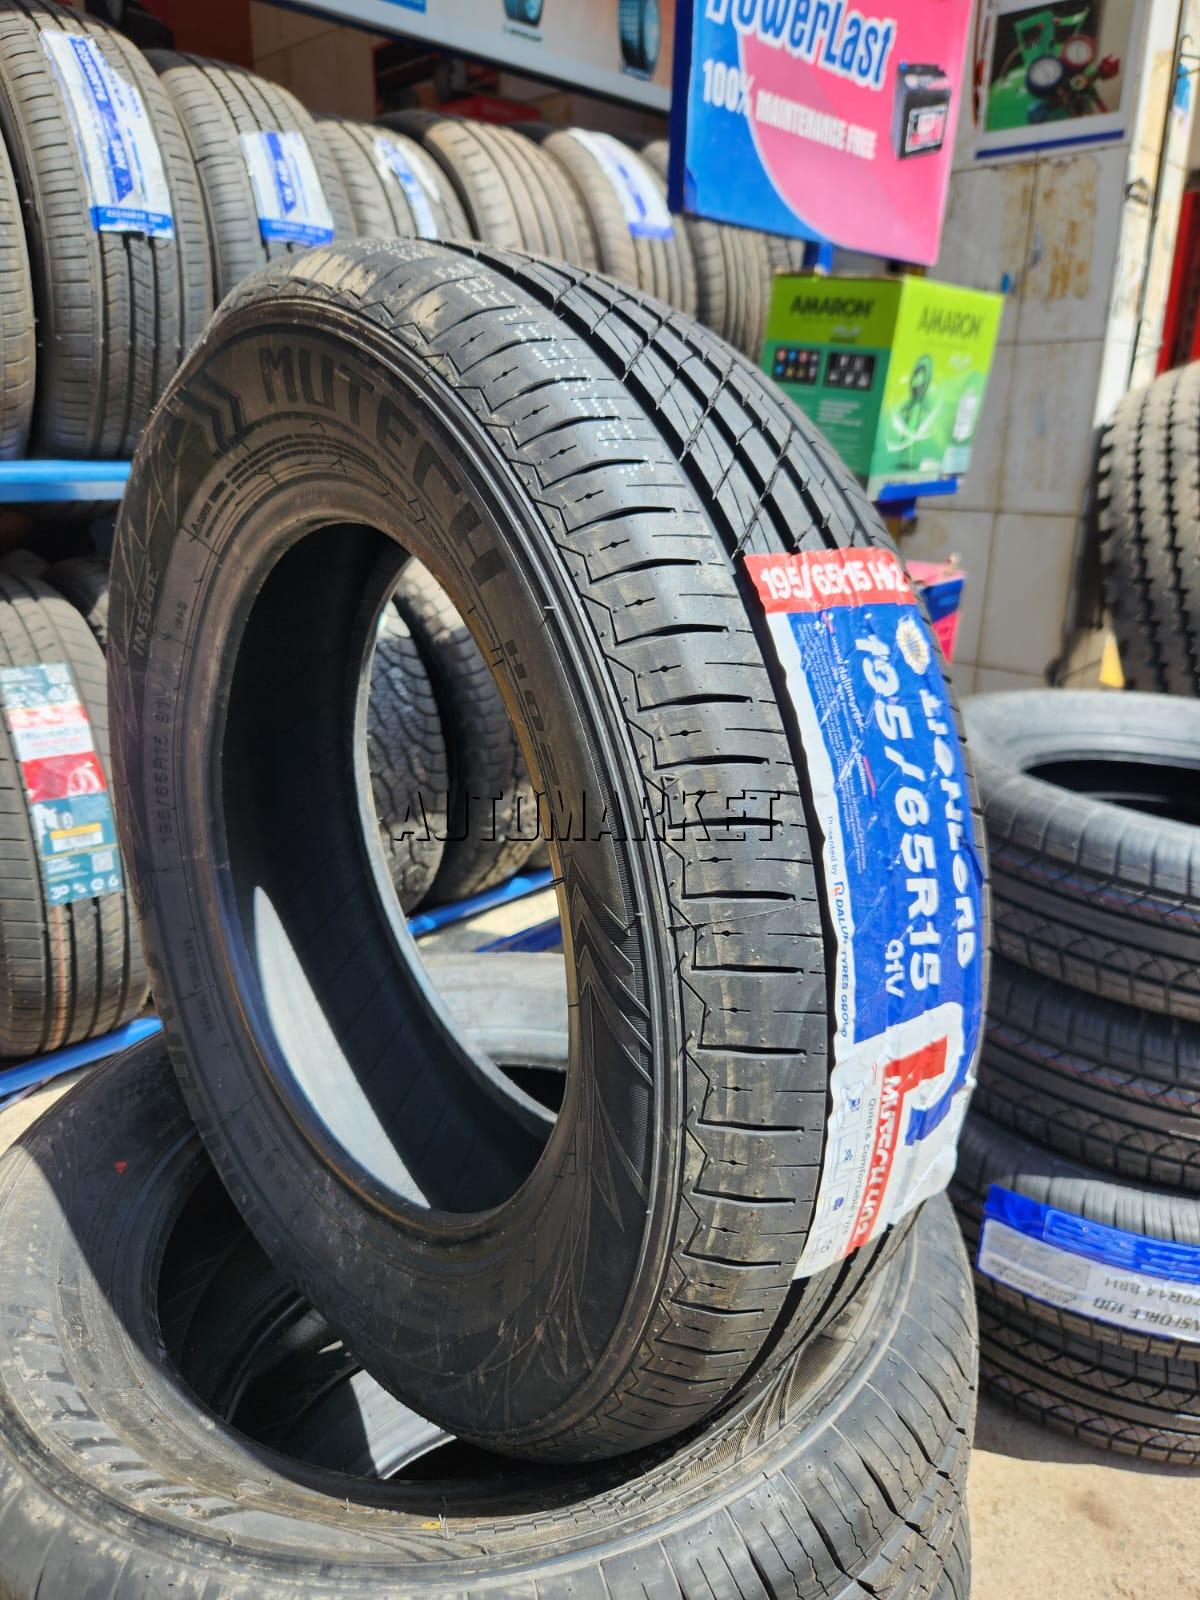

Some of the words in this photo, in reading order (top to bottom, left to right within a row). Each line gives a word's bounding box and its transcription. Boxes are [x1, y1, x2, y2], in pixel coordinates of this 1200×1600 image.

[703, 59, 754, 118] 100%
[755, 89, 848, 151] MAINTENANCE
[846, 123, 878, 160] FREE
[790, 295, 875, 319] AMARON
[855, 633, 941, 992] 195/65R15
